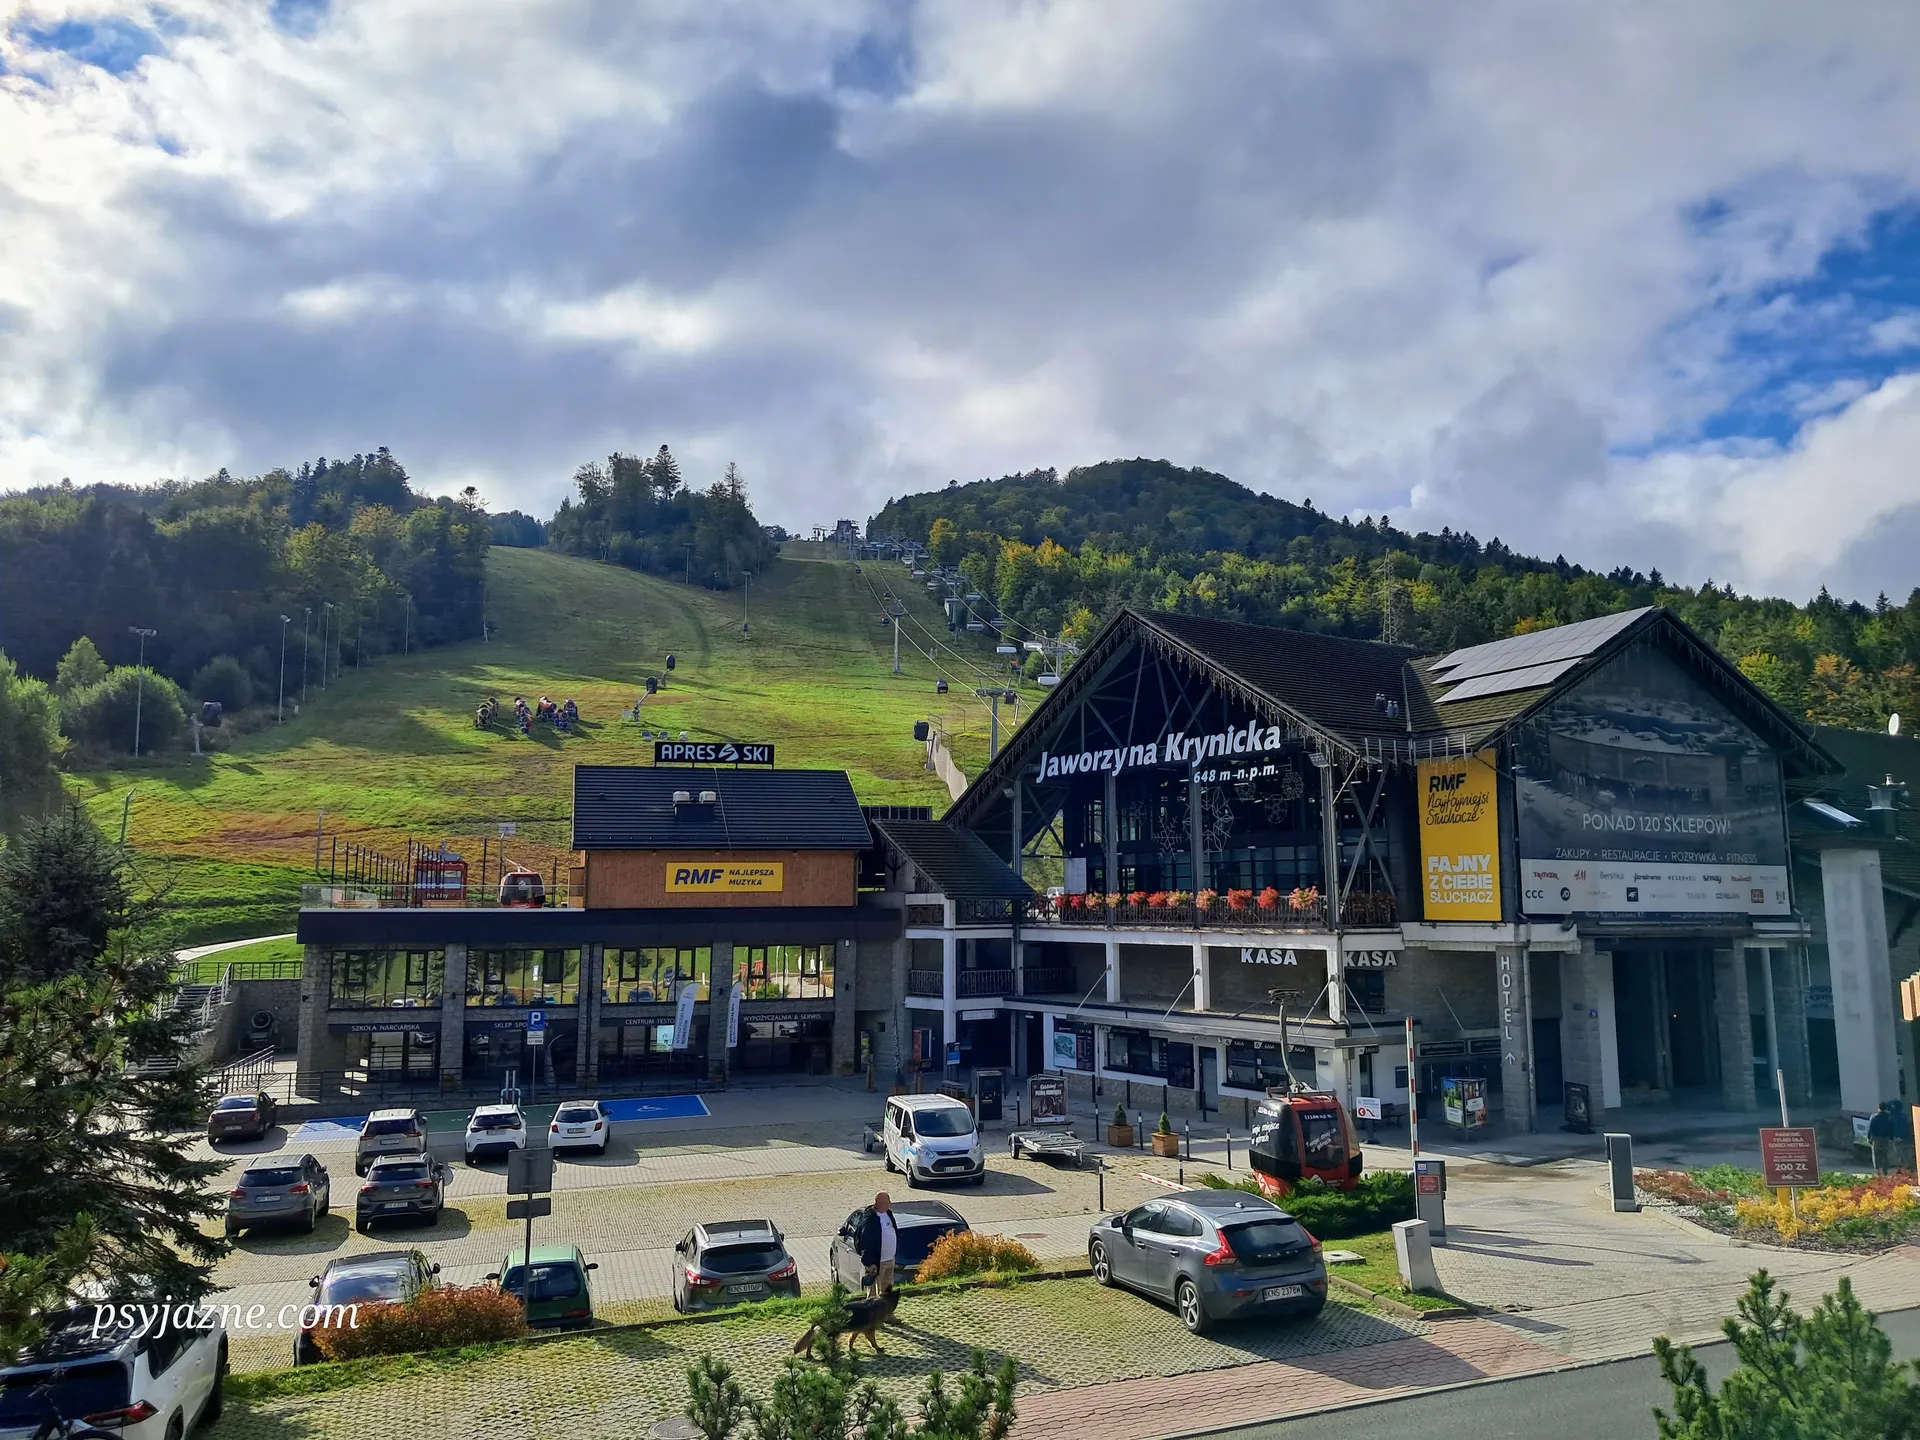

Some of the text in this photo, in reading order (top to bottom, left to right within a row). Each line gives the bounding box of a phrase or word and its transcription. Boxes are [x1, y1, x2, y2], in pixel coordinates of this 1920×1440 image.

[661, 744, 768, 761] APRES SKI
[1036, 719, 1280, 783] Jaworzyna Krynicka
[1193, 770, 1215, 784] 648
[1429, 773, 1467, 792] RMF
[1582, 814, 1732, 834] PONAD 120 SKLEPÓW!
[1428, 855, 1491, 873] FAJNY
[1555, 848, 1758, 864] ZAKUPY RESTAURACJE ROZRYWKA FITNESS
[674, 869, 724, 885] RMF
[1429, 874, 1493, 890] Z CIEBIE
[1429, 891, 1494, 903] SŁUCHACZ
[1525, 889, 1544, 899] CCC
[1241, 948, 1297, 965] KASA
[1344, 951, 1397, 967] KASA
[1501, 956, 1512, 1040] HOTEL
[531, 1012, 541, 1025] P
[1775, 1163, 1793, 1171] 200
[1267, 1288, 1281, 1298] KNS
